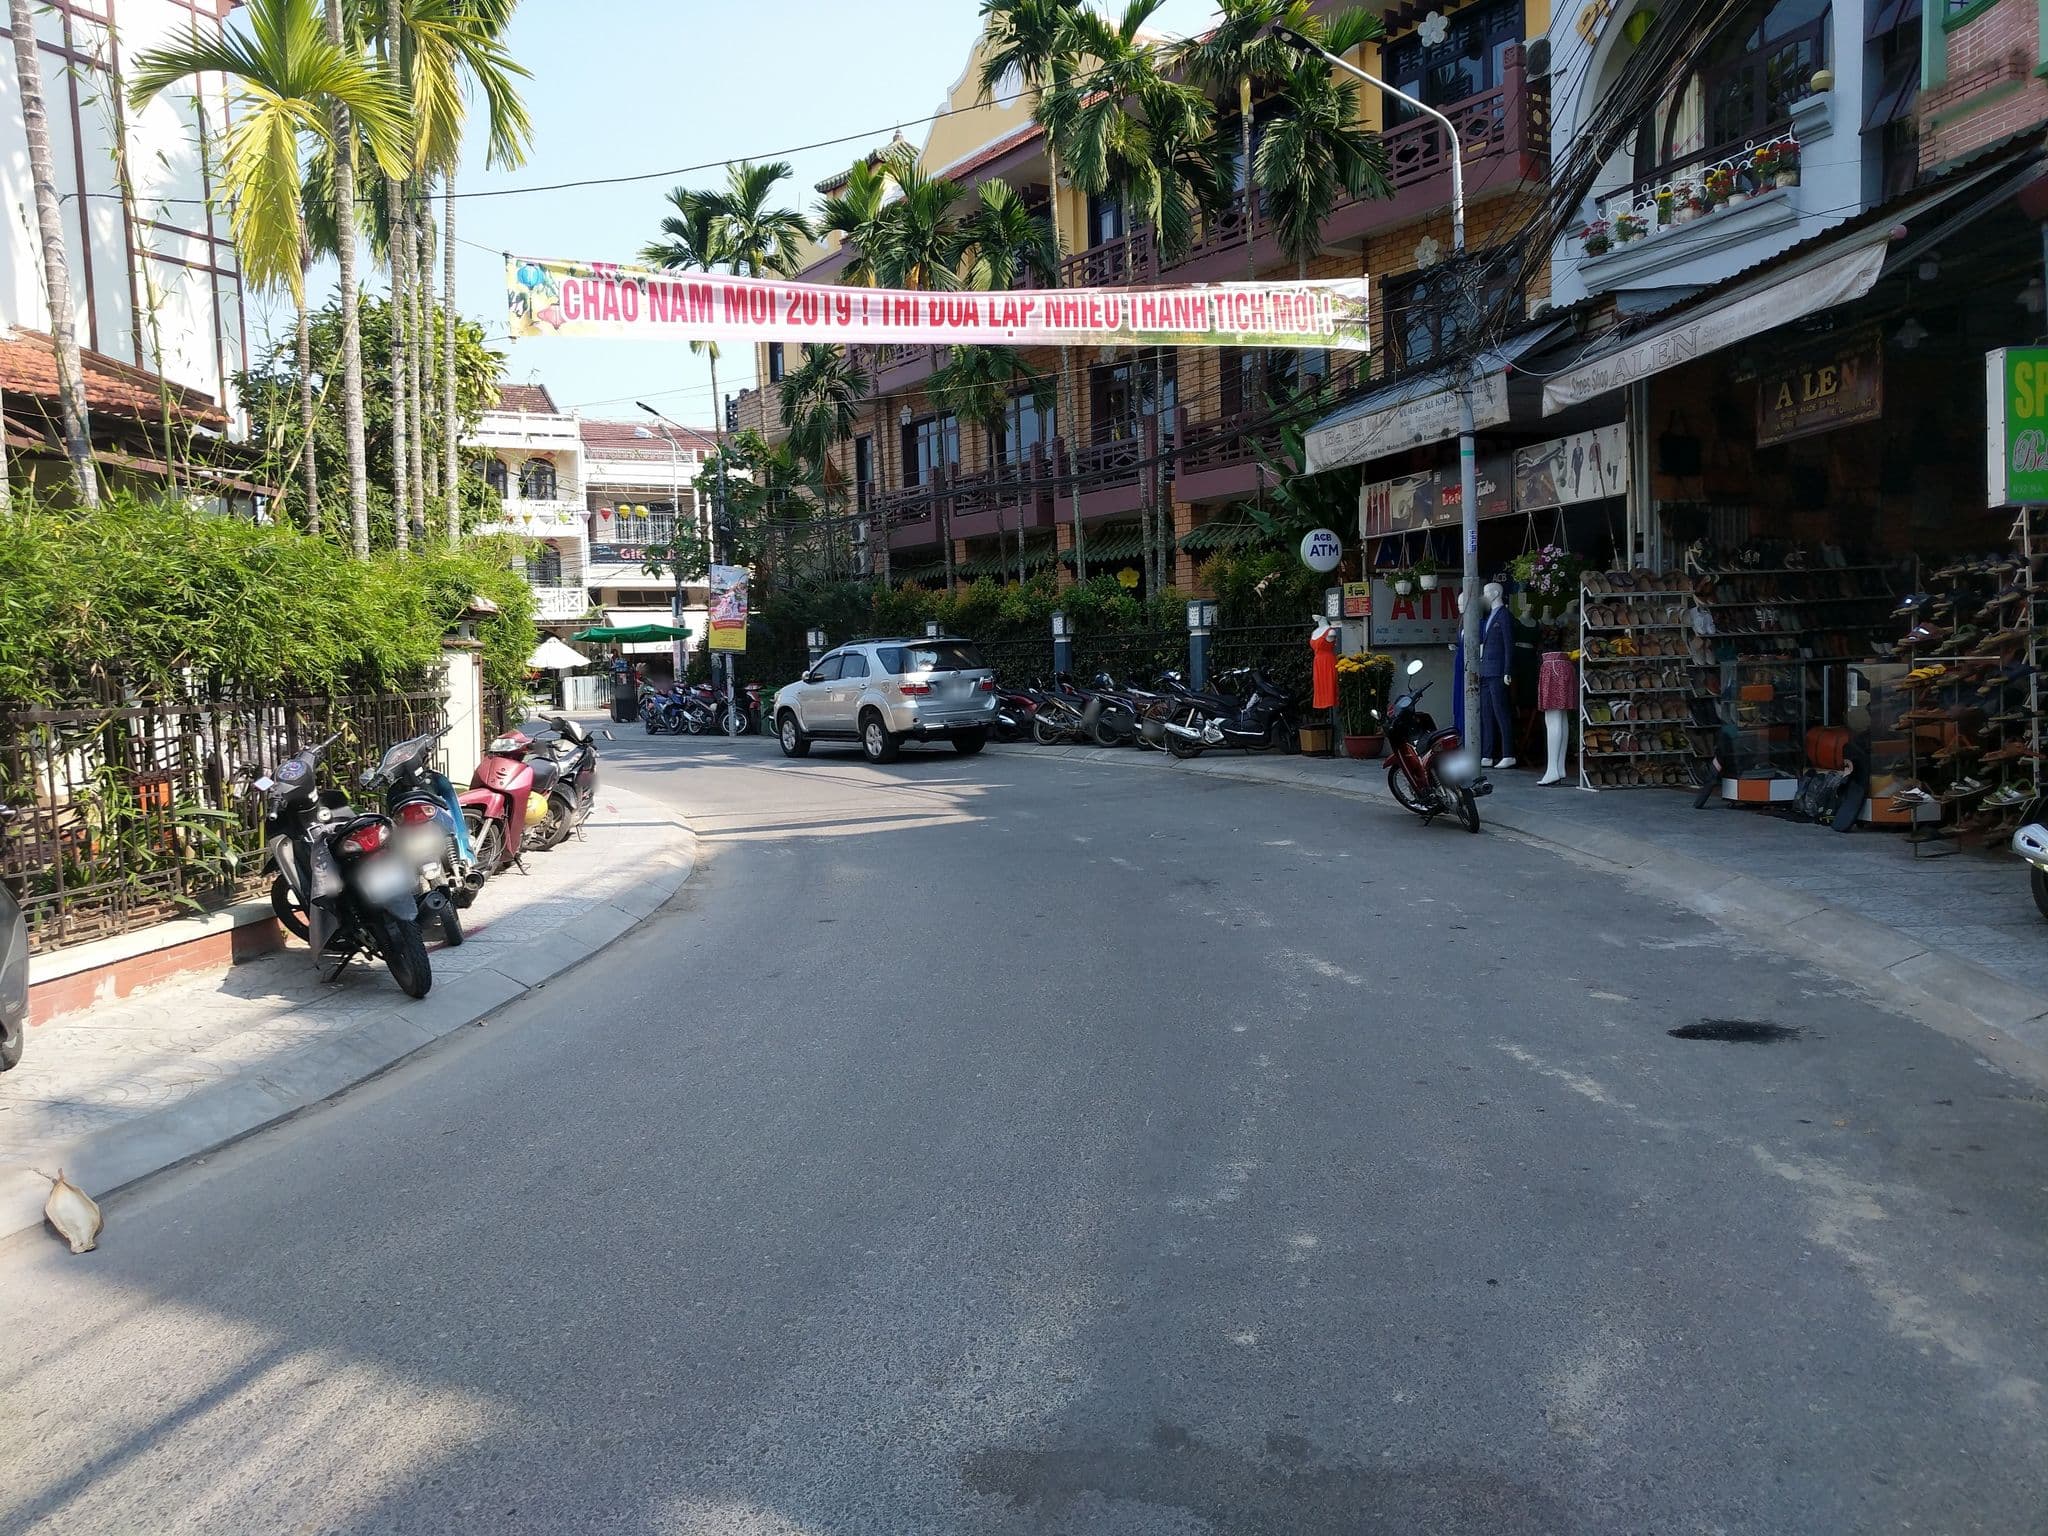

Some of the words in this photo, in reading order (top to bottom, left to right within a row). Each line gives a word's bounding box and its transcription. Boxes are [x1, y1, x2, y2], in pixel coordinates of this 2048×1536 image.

[786, 289, 851, 326] 2019
[863, 294, 869, 326] !
[1611, 325, 1700, 387] ALEN
[1310, 544, 1339, 557] ATM
[1313, 534, 1332, 542] ACB
